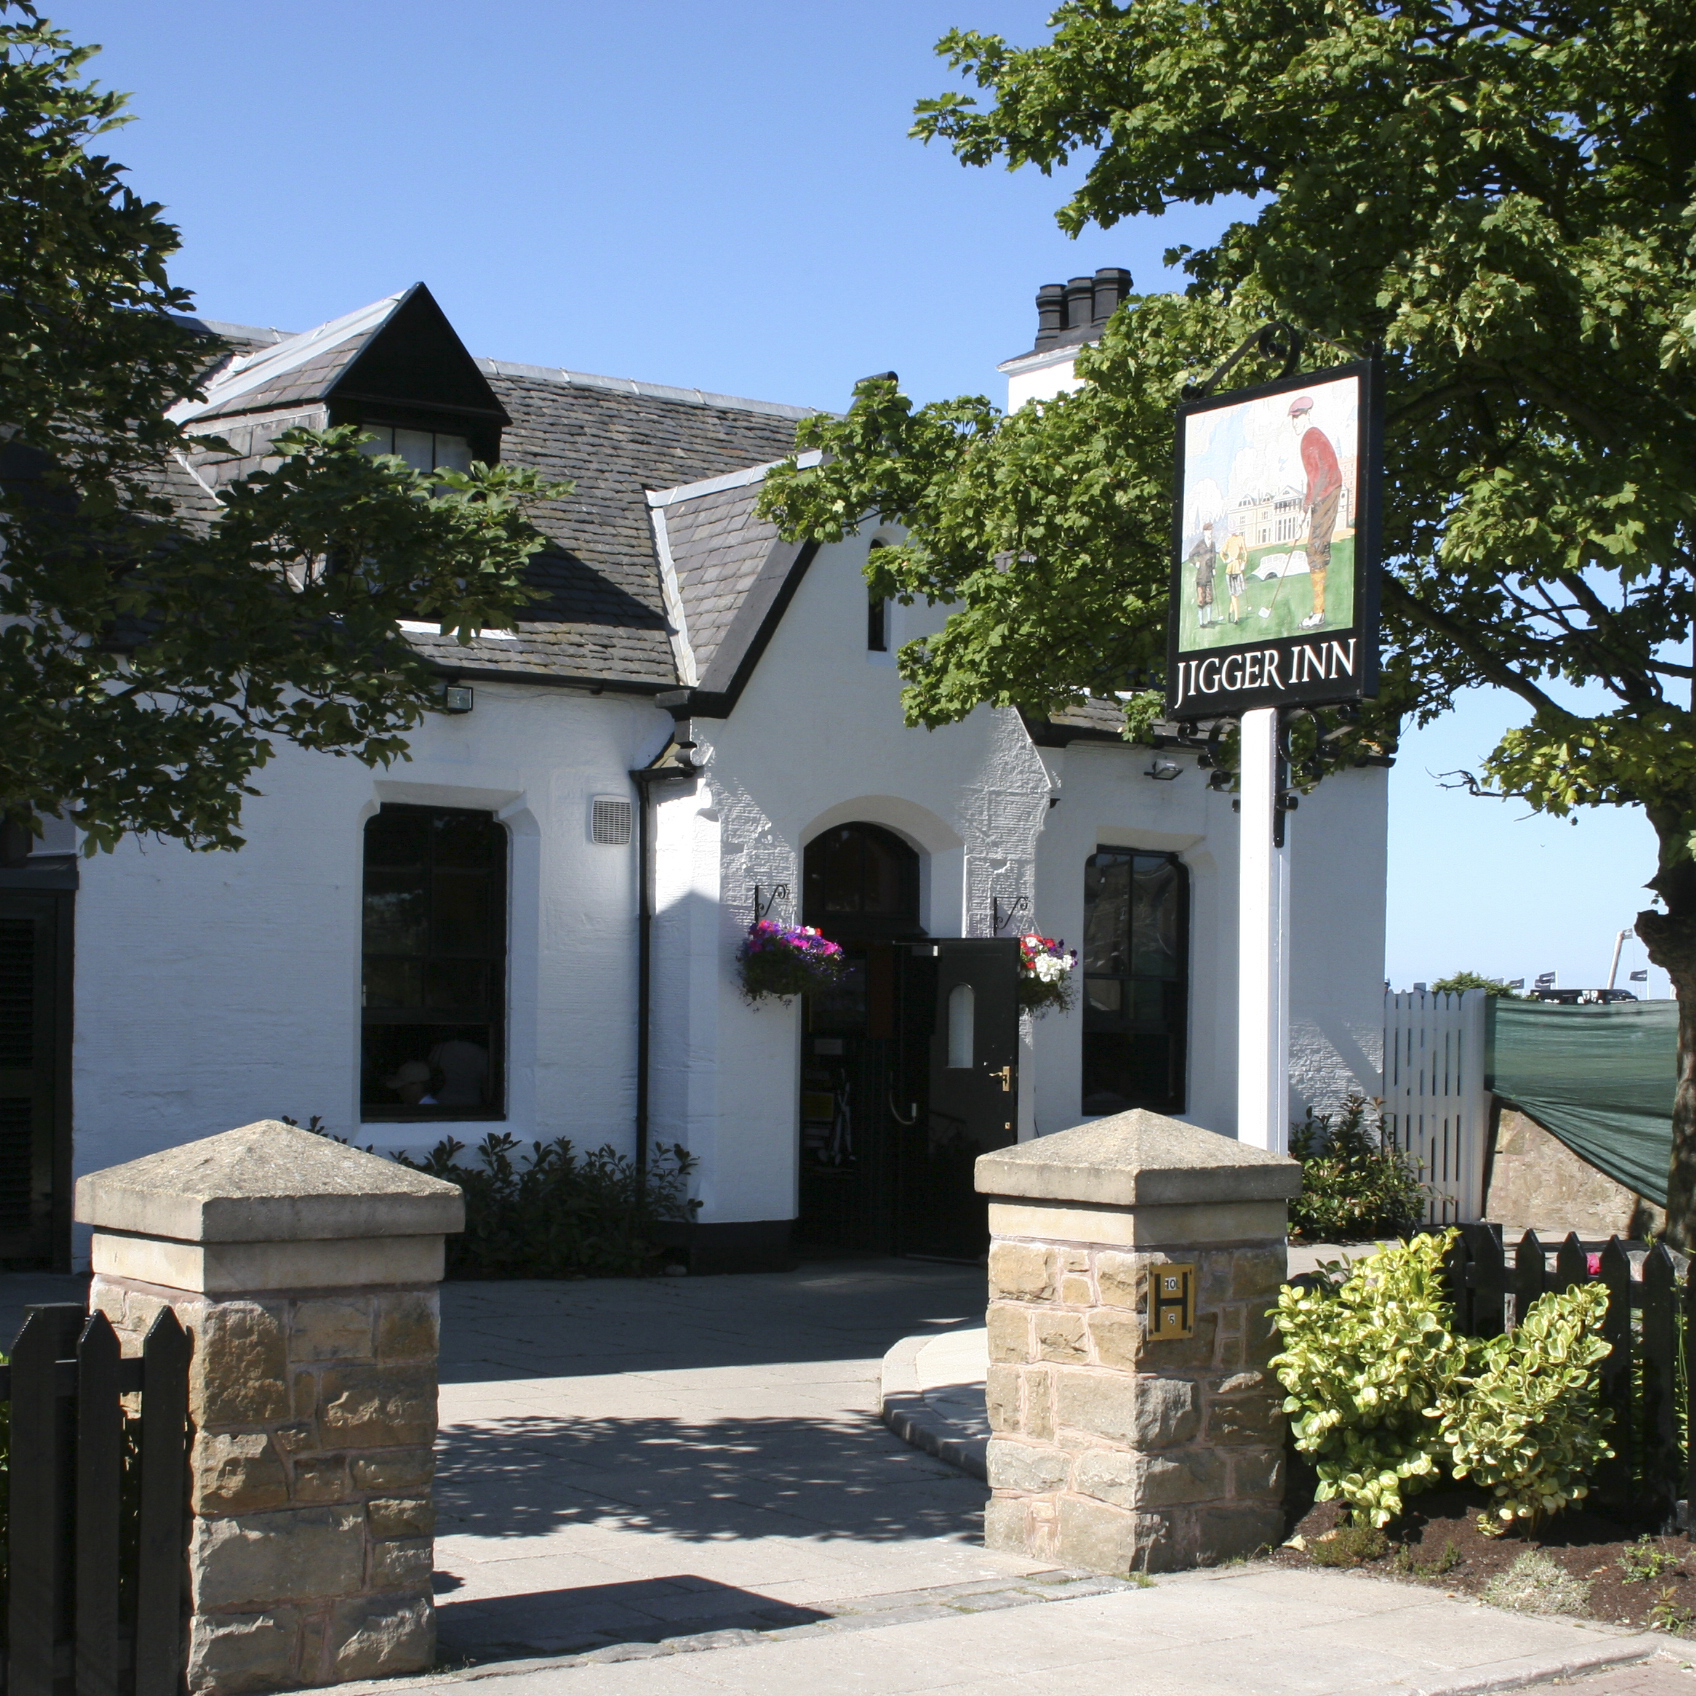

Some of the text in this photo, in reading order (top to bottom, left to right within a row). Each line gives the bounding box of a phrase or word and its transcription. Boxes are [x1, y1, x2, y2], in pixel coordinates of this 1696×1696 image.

[1174, 638, 1357, 709] JIGGER INN
[1154, 1272, 1188, 1332] H
[1165, 1278, 1177, 1291] 10
